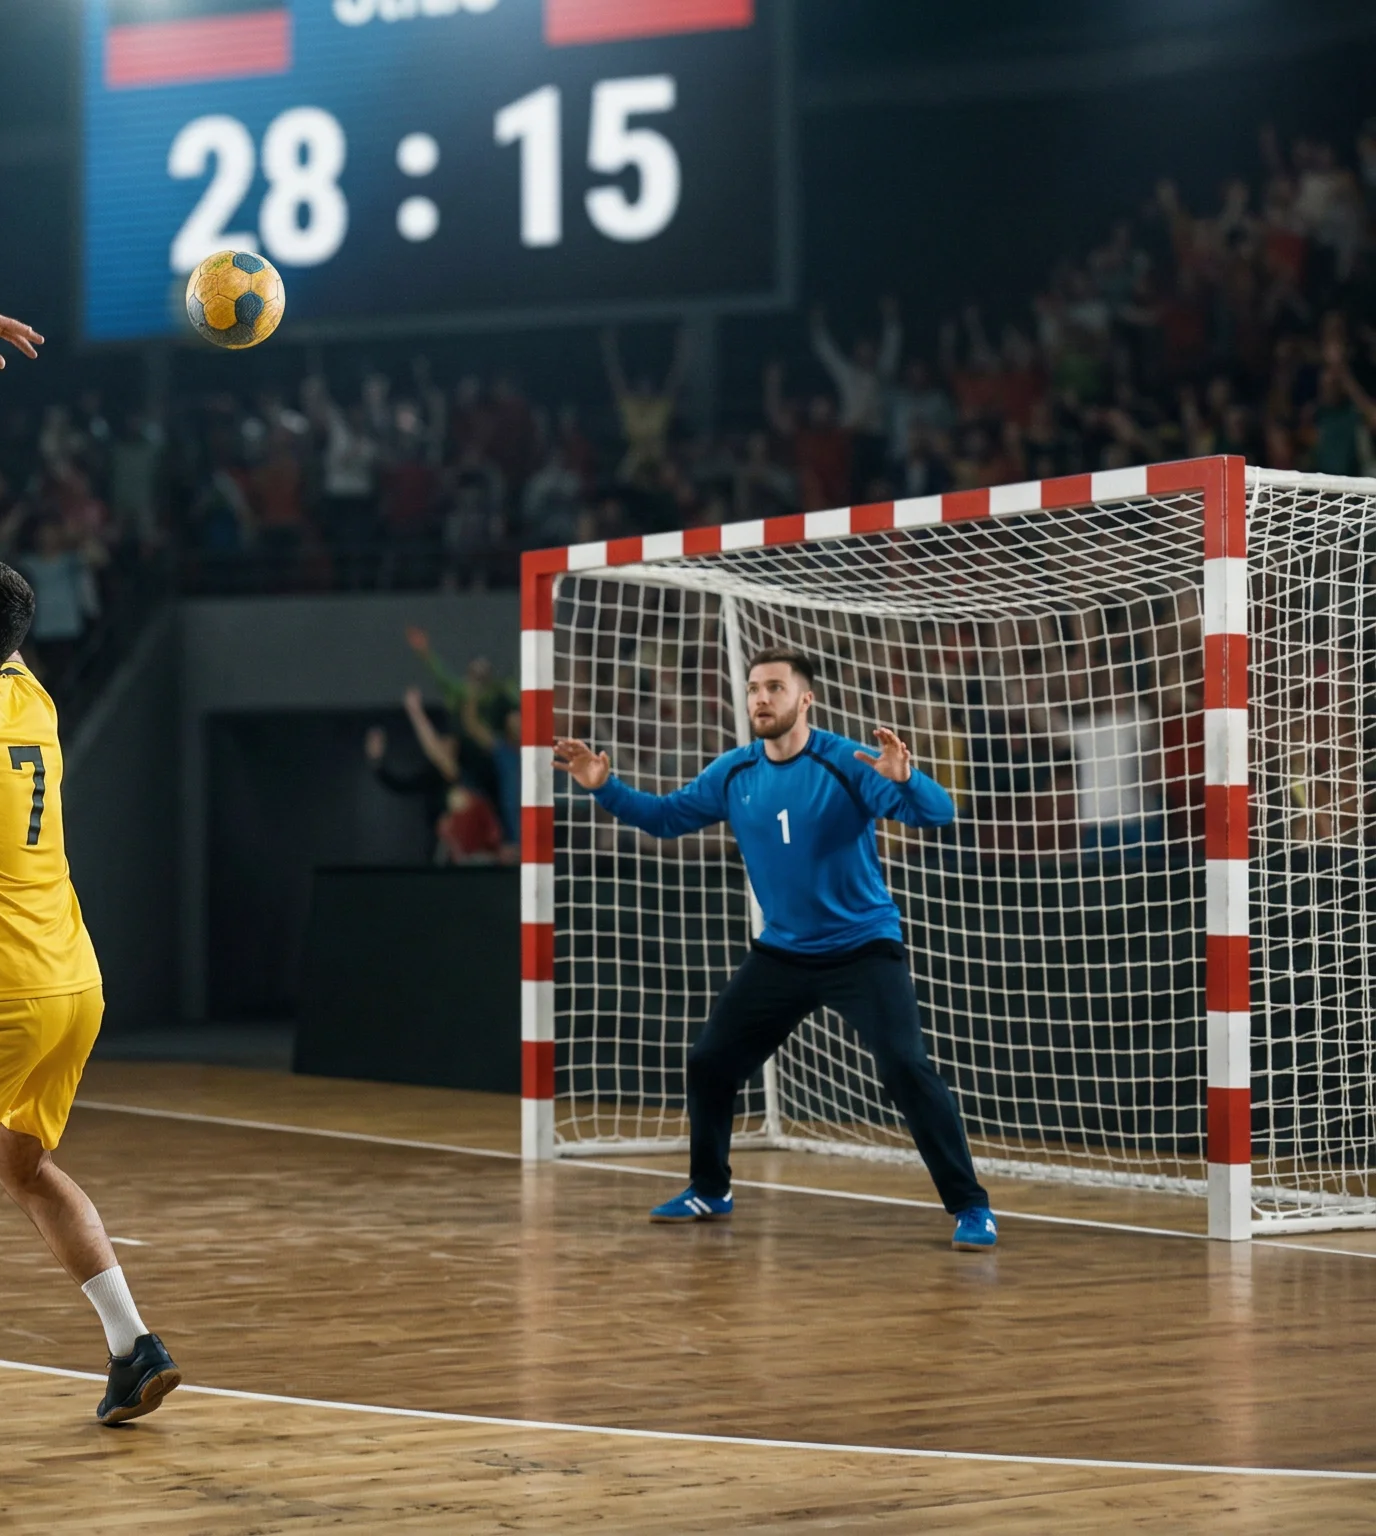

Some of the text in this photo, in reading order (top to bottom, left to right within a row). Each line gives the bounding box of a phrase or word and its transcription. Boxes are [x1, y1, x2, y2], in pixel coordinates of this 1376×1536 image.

[167, 74, 680, 274] 28 : 15
[8, 745, 45, 845] 7
[777, 808, 791, 844] 1
